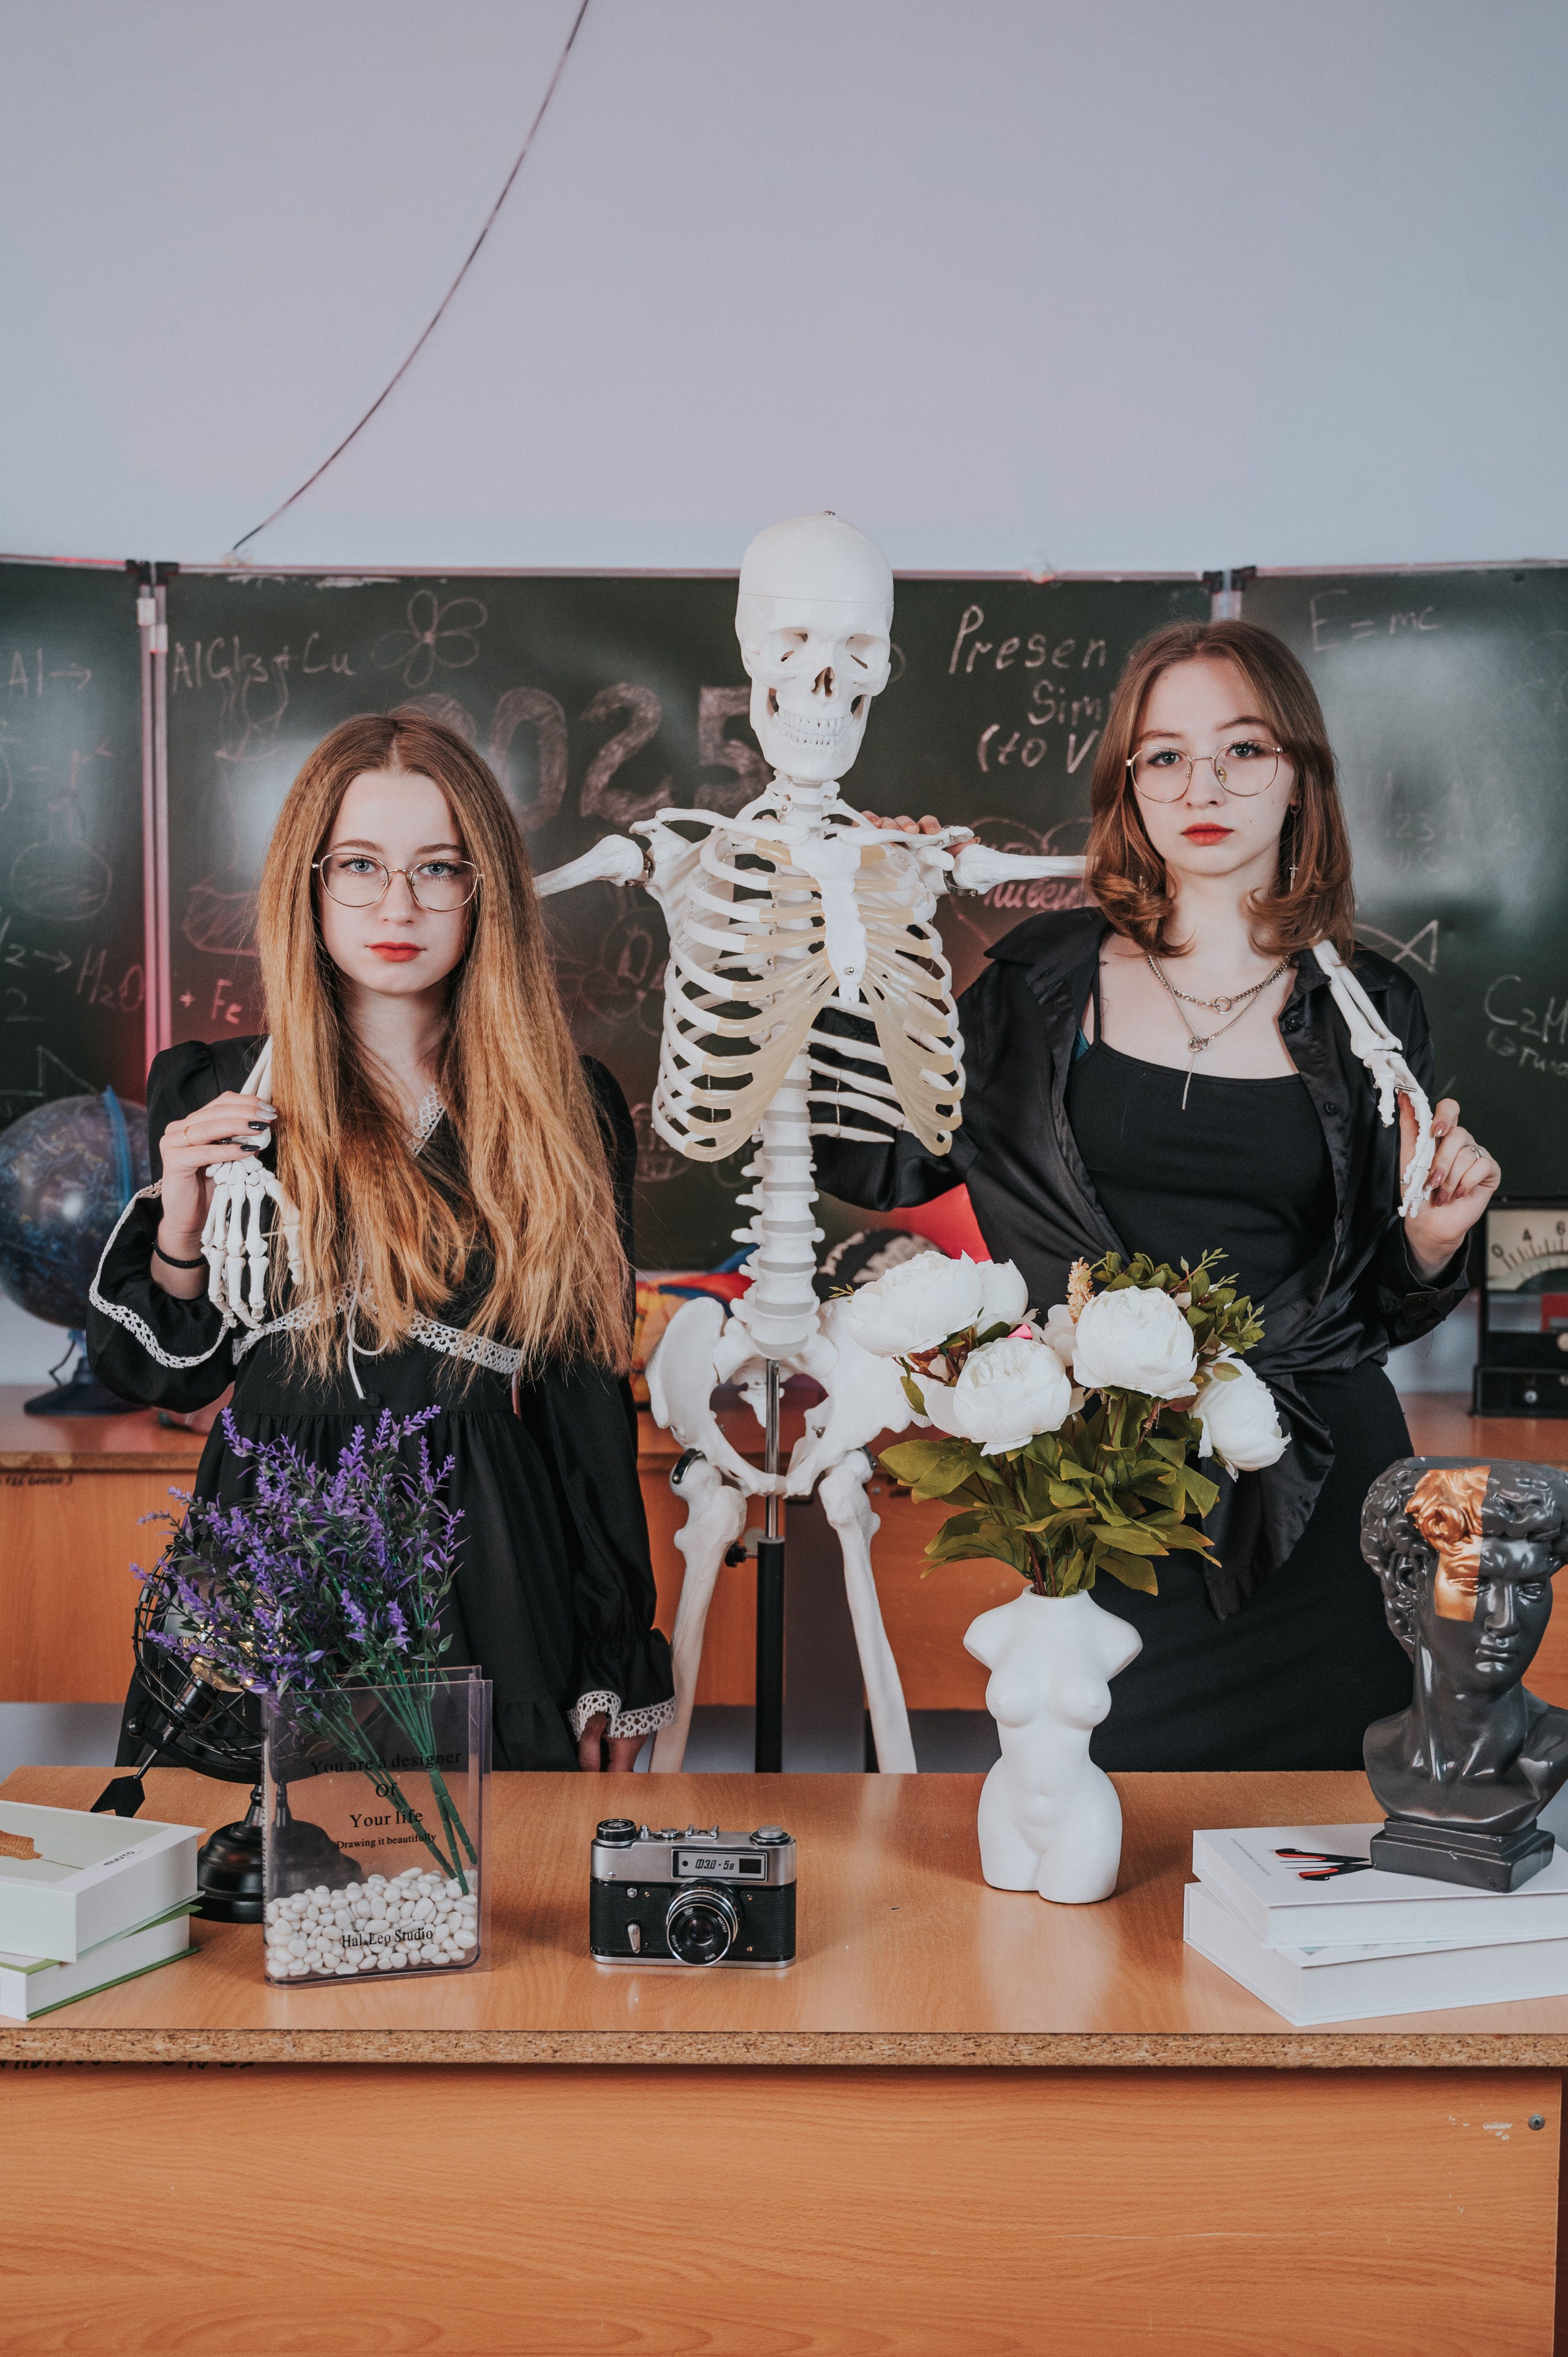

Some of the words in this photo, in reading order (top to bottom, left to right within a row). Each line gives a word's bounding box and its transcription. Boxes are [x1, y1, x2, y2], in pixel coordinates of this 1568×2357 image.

[310, 1761, 344, 1774] You
[349, 1760, 374, 1771] are
[379, 1760, 387, 1769] a
[391, 1753, 462, 1770] designer
[375, 1782, 399, 1797] Of
[349, 1814, 391, 1828] Your
[396, 1809, 424, 1824] life
[337, 1838, 376, 1849] Drawing
[378, 1836, 385, 1846] it
[387, 1833, 436, 1845] beautifully
[394, 1927, 434, 1943] Studio
